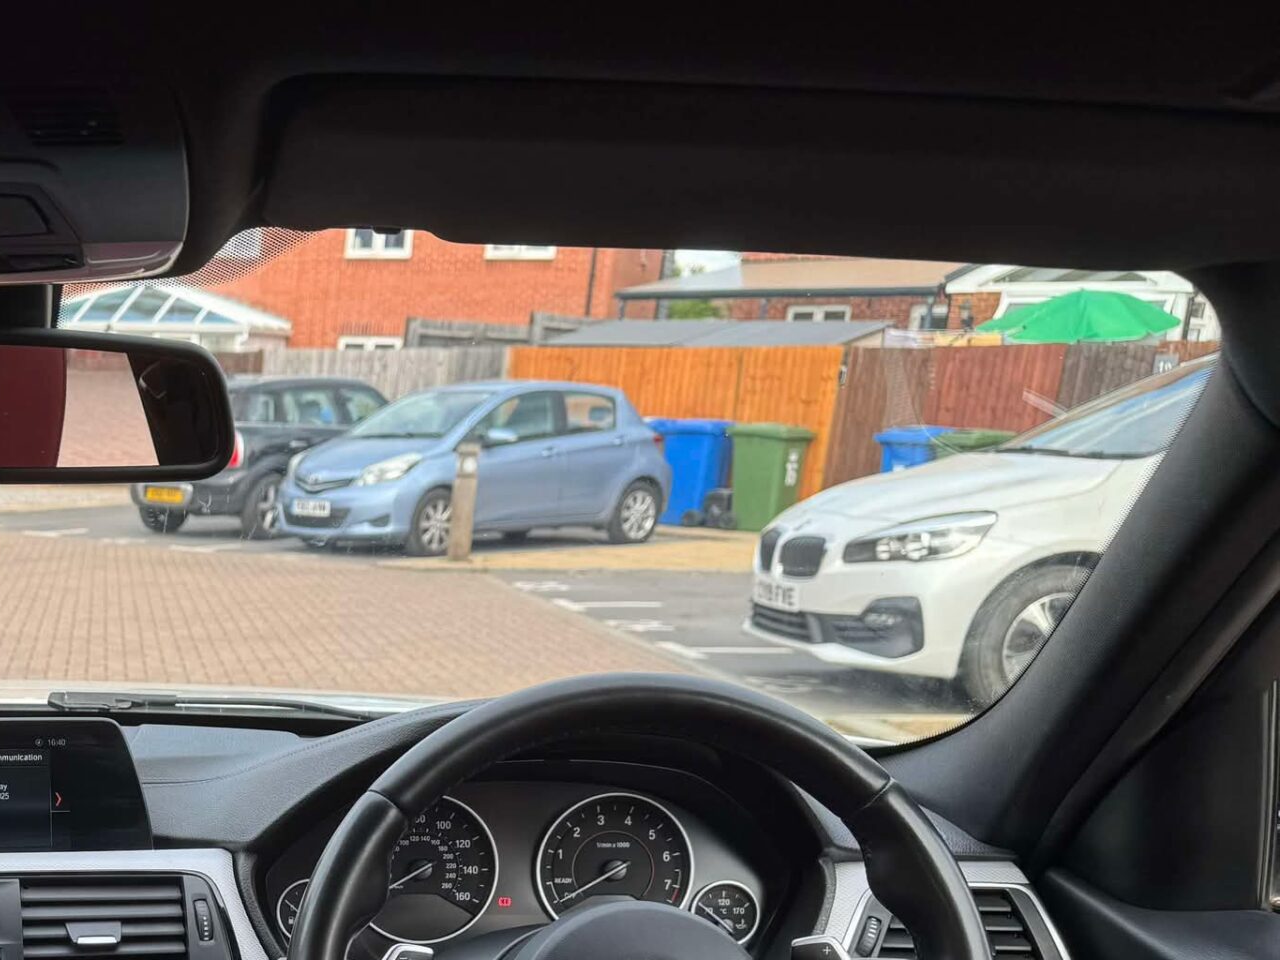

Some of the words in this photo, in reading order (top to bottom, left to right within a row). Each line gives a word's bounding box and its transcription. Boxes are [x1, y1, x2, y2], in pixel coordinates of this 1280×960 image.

[597, 816, 605, 826] 3
[624, 816, 632, 825] 4
[436, 821, 451, 830] 100
[573, 828, 580, 837] 2
[649, 830, 656, 840] 5
[456, 840, 470, 848] 120
[557, 850, 563, 859] 1
[663, 852, 670, 862] 6
[463, 866, 478, 874] 140
[664, 880, 671, 890] 7
[455, 892, 470, 901] 160
[733, 907, 745, 915] 170
